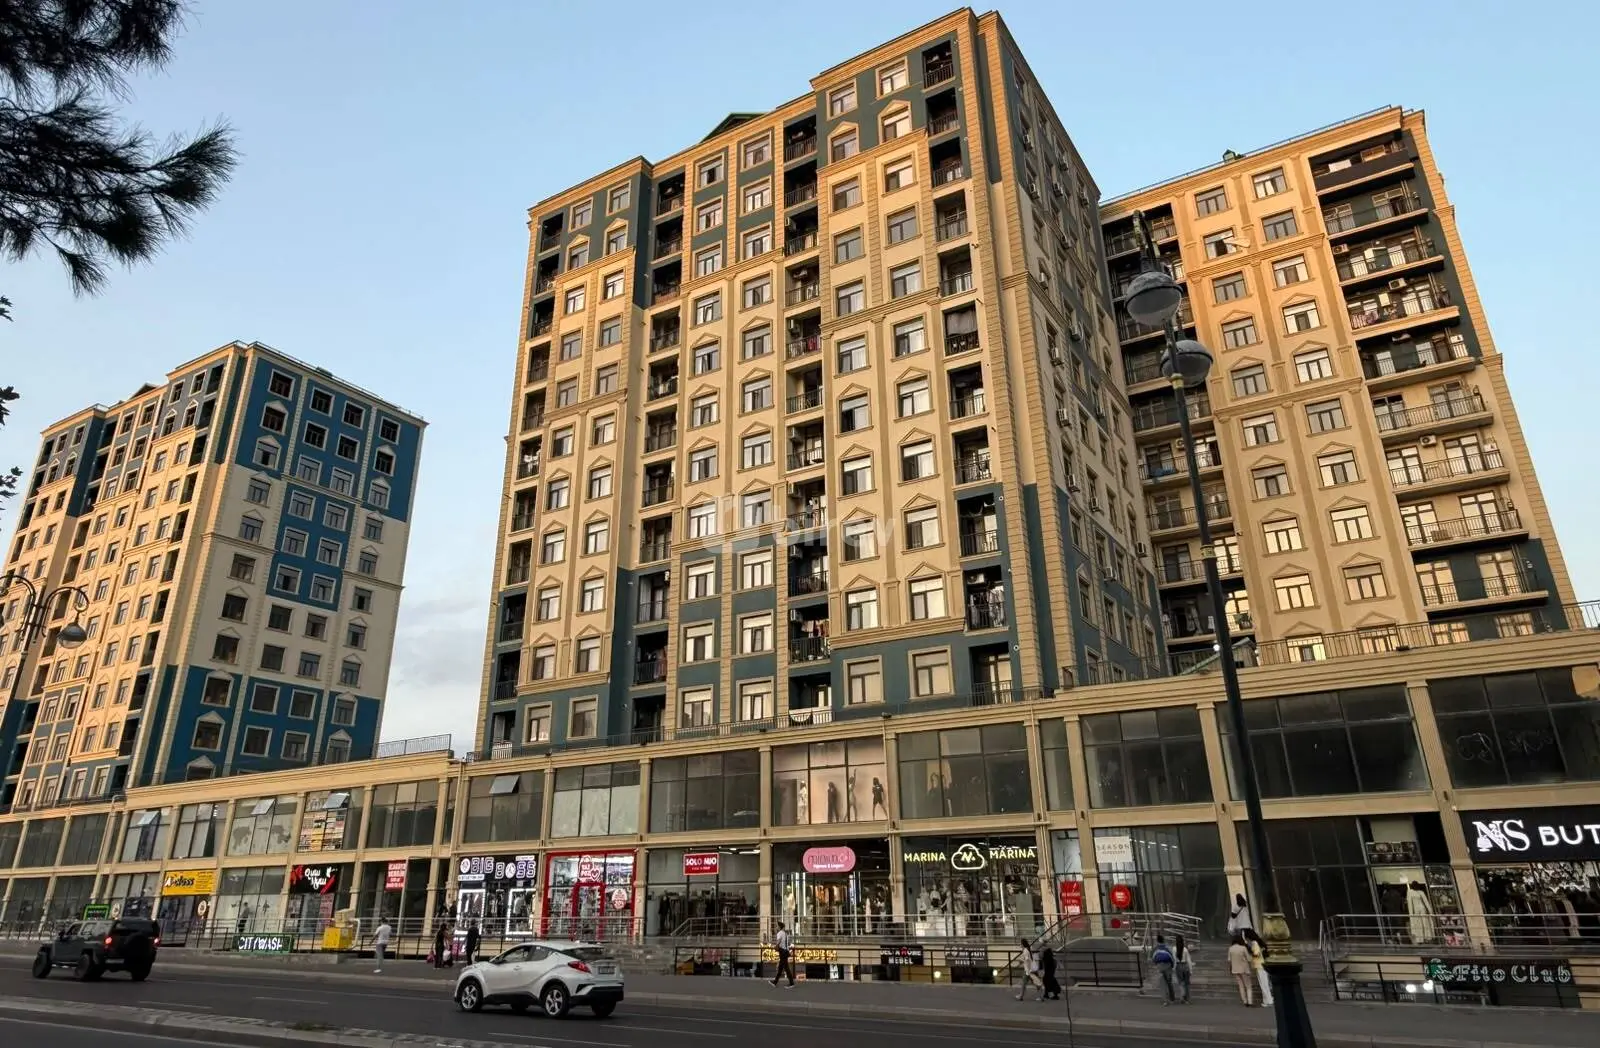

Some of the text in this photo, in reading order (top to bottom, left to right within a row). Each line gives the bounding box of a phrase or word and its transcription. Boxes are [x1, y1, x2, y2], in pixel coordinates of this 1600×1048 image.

[904, 851, 946, 863] MARINA
[989, 848, 1036, 860] MARINA
[470, 857, 494, 874] BIG
[686, 857, 717, 866] SOLO MIO
[888, 956, 914, 964] MEBEL
[1452, 963, 1571, 982] Fito Club
